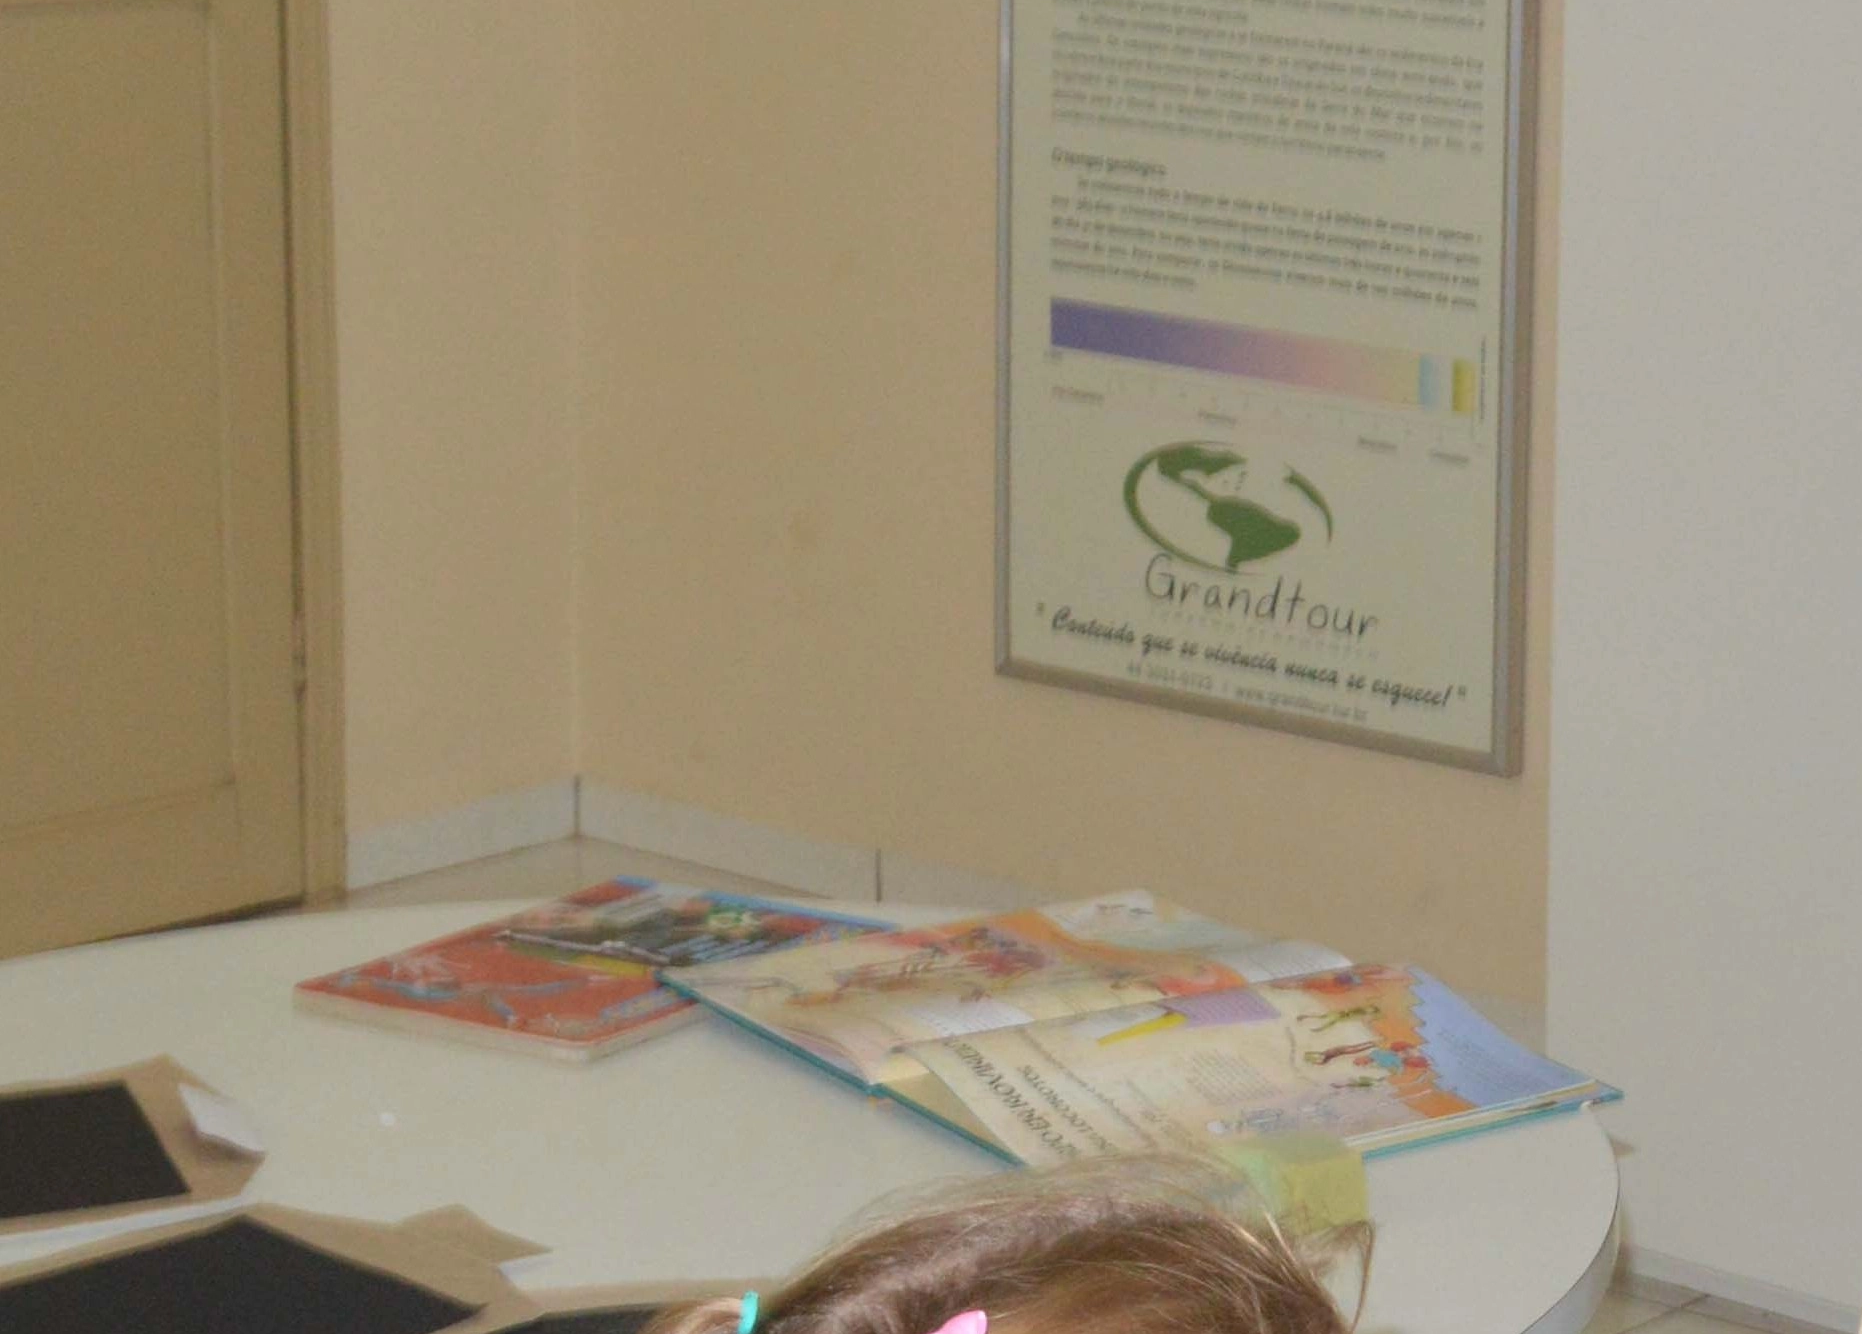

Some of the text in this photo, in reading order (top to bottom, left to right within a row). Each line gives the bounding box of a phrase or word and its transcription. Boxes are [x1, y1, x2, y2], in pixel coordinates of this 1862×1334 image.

[1144, 551, 1380, 637] Grandtour
[1141, 632, 1174, 657] que
[1180, 639, 1199, 656] se
[1204, 642, 1279, 673] vivência
[1284, 660, 1339, 685] nunca
[1346, 672, 1366, 690] se
[1371, 677, 1455, 708] esquece!
